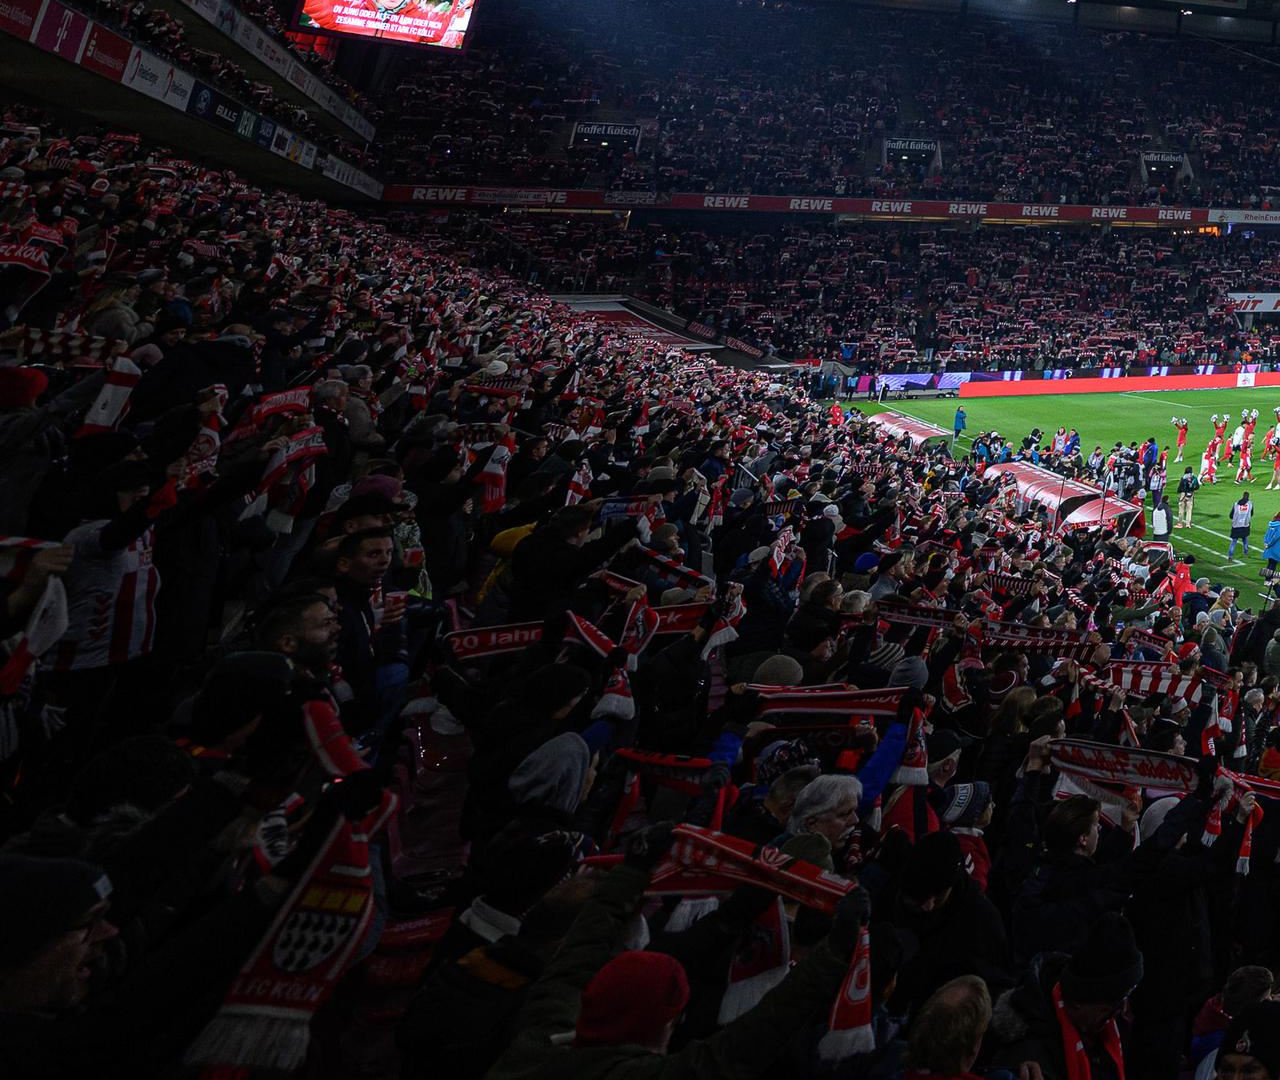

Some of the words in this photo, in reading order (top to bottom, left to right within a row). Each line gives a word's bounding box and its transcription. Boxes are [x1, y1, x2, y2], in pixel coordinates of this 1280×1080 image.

[216, 104, 239, 121] BULLS
[577, 124, 606, 135] Gaffel
[607, 125, 640, 137] Kölsch
[886, 140, 909, 150] Gaffel
[910, 140, 937, 151] Kölsch
[412, 187, 467, 201] REWE
[704, 196, 750, 208] REWE
[790, 199, 833, 211] REWE
[871, 201, 912, 213] REWE
[948, 203, 988, 214] REWE
[1022, 205, 1060, 217] REWE
[1091, 207, 1127, 219] REWE
[1158, 209, 1192, 220] REWE
[449, 634, 481, 654] 20
[487, 627, 543, 647] Jahr
